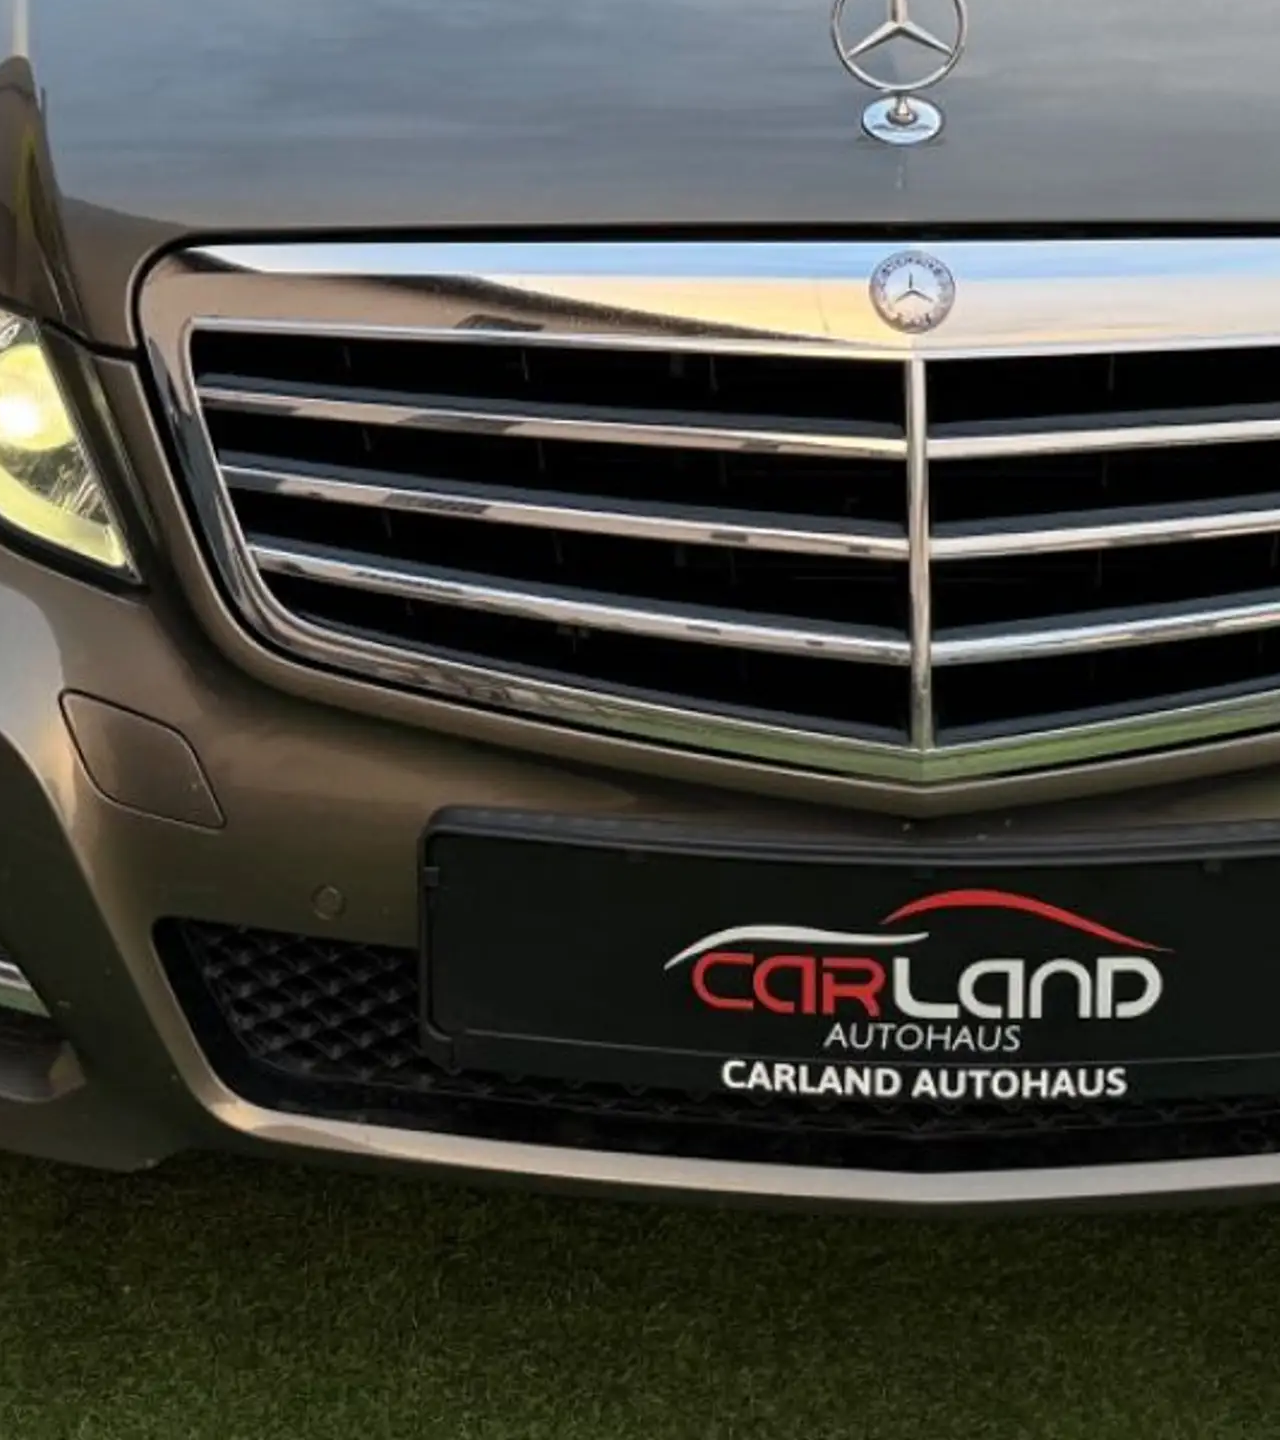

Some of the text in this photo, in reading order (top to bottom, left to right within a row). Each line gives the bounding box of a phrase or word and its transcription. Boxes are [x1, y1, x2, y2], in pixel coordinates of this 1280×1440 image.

[691, 952, 1164, 1019] CARLAND
[823, 1021, 1021, 1053] AUTOHAUS
[722, 1059, 1128, 1100] CARLAND AUTOHAUS
